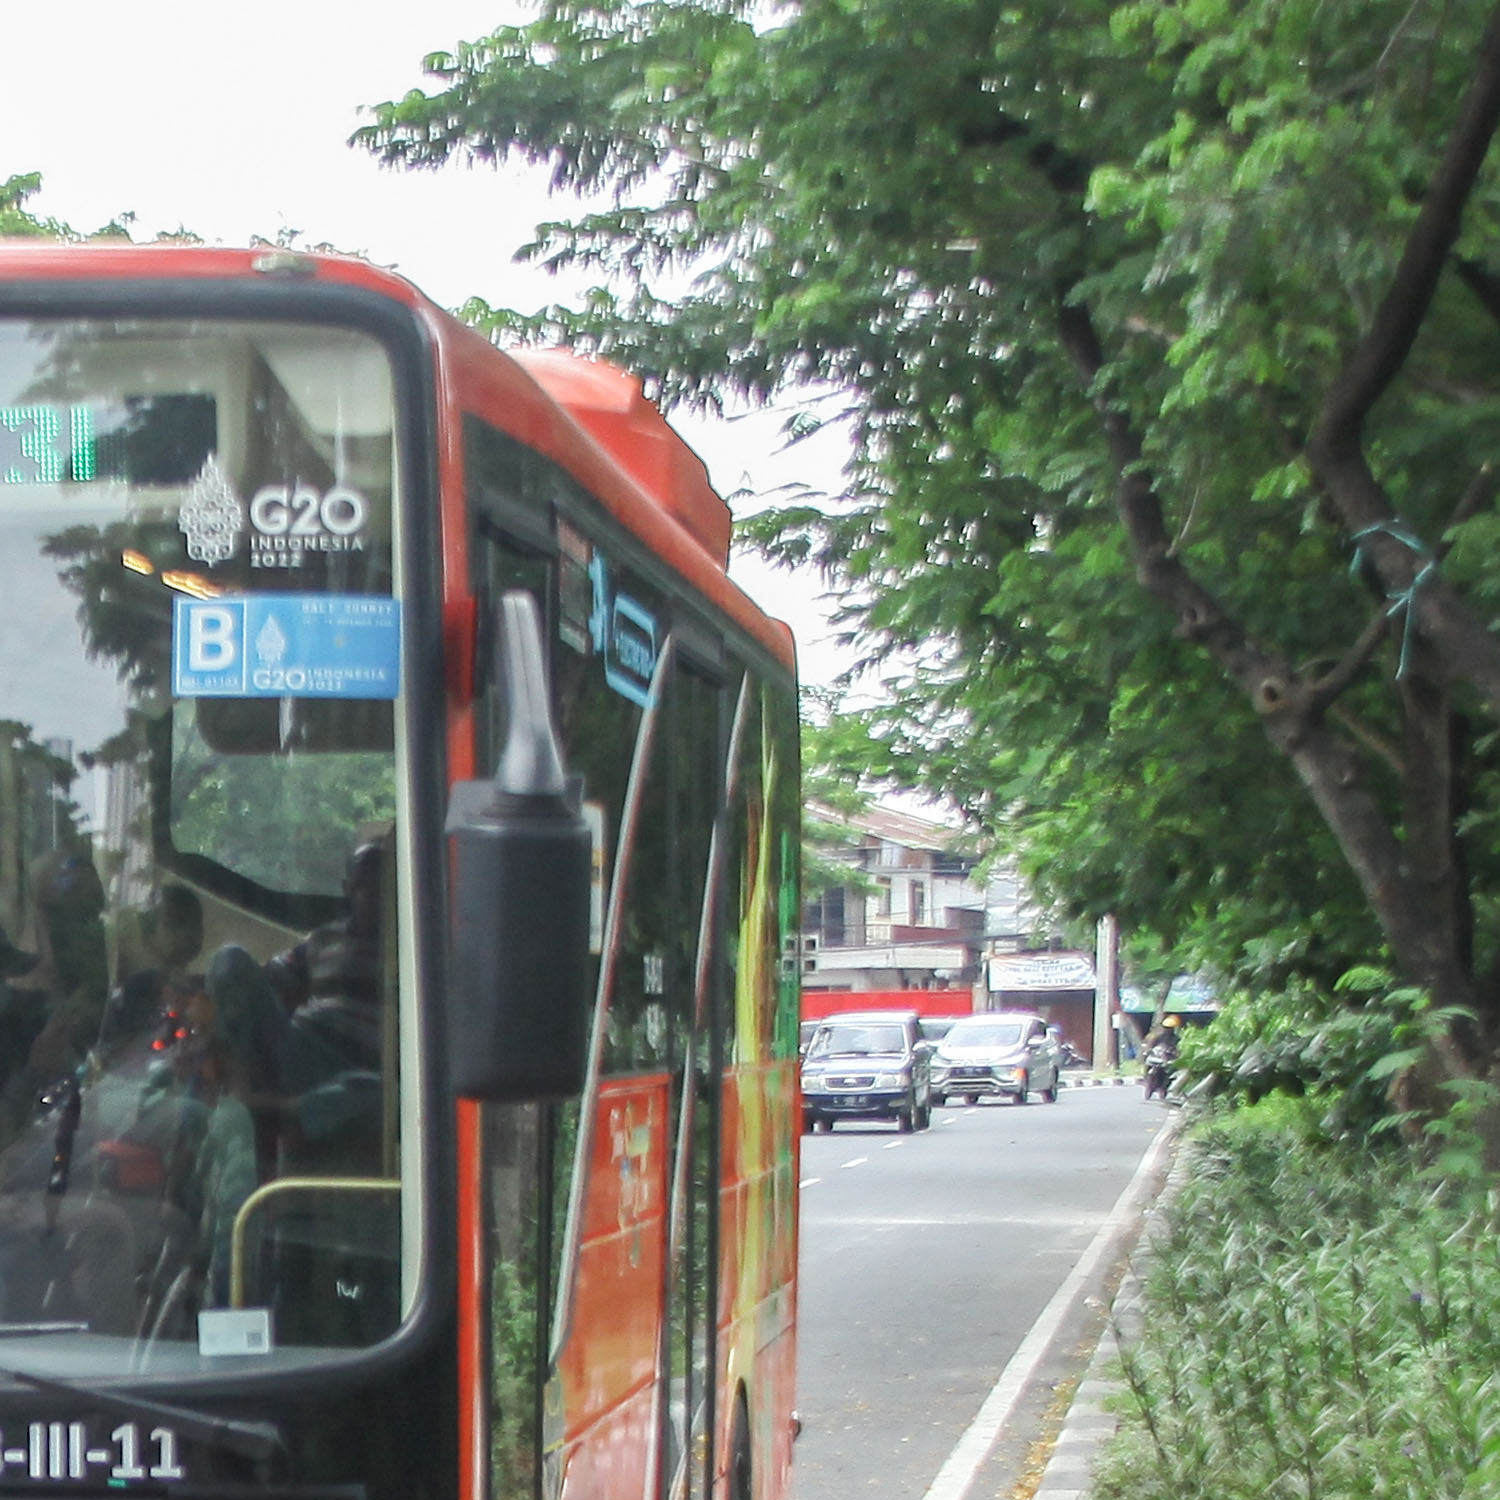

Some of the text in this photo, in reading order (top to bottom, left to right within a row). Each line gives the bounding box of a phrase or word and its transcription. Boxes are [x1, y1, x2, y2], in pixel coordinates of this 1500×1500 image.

[250, 485, 364, 537] G20
[250, 536, 363, 551] INDONESIA
[250, 552, 301, 568] 2022
[188, 605, 237, 672] B
[252, 670, 306, 690] G20
